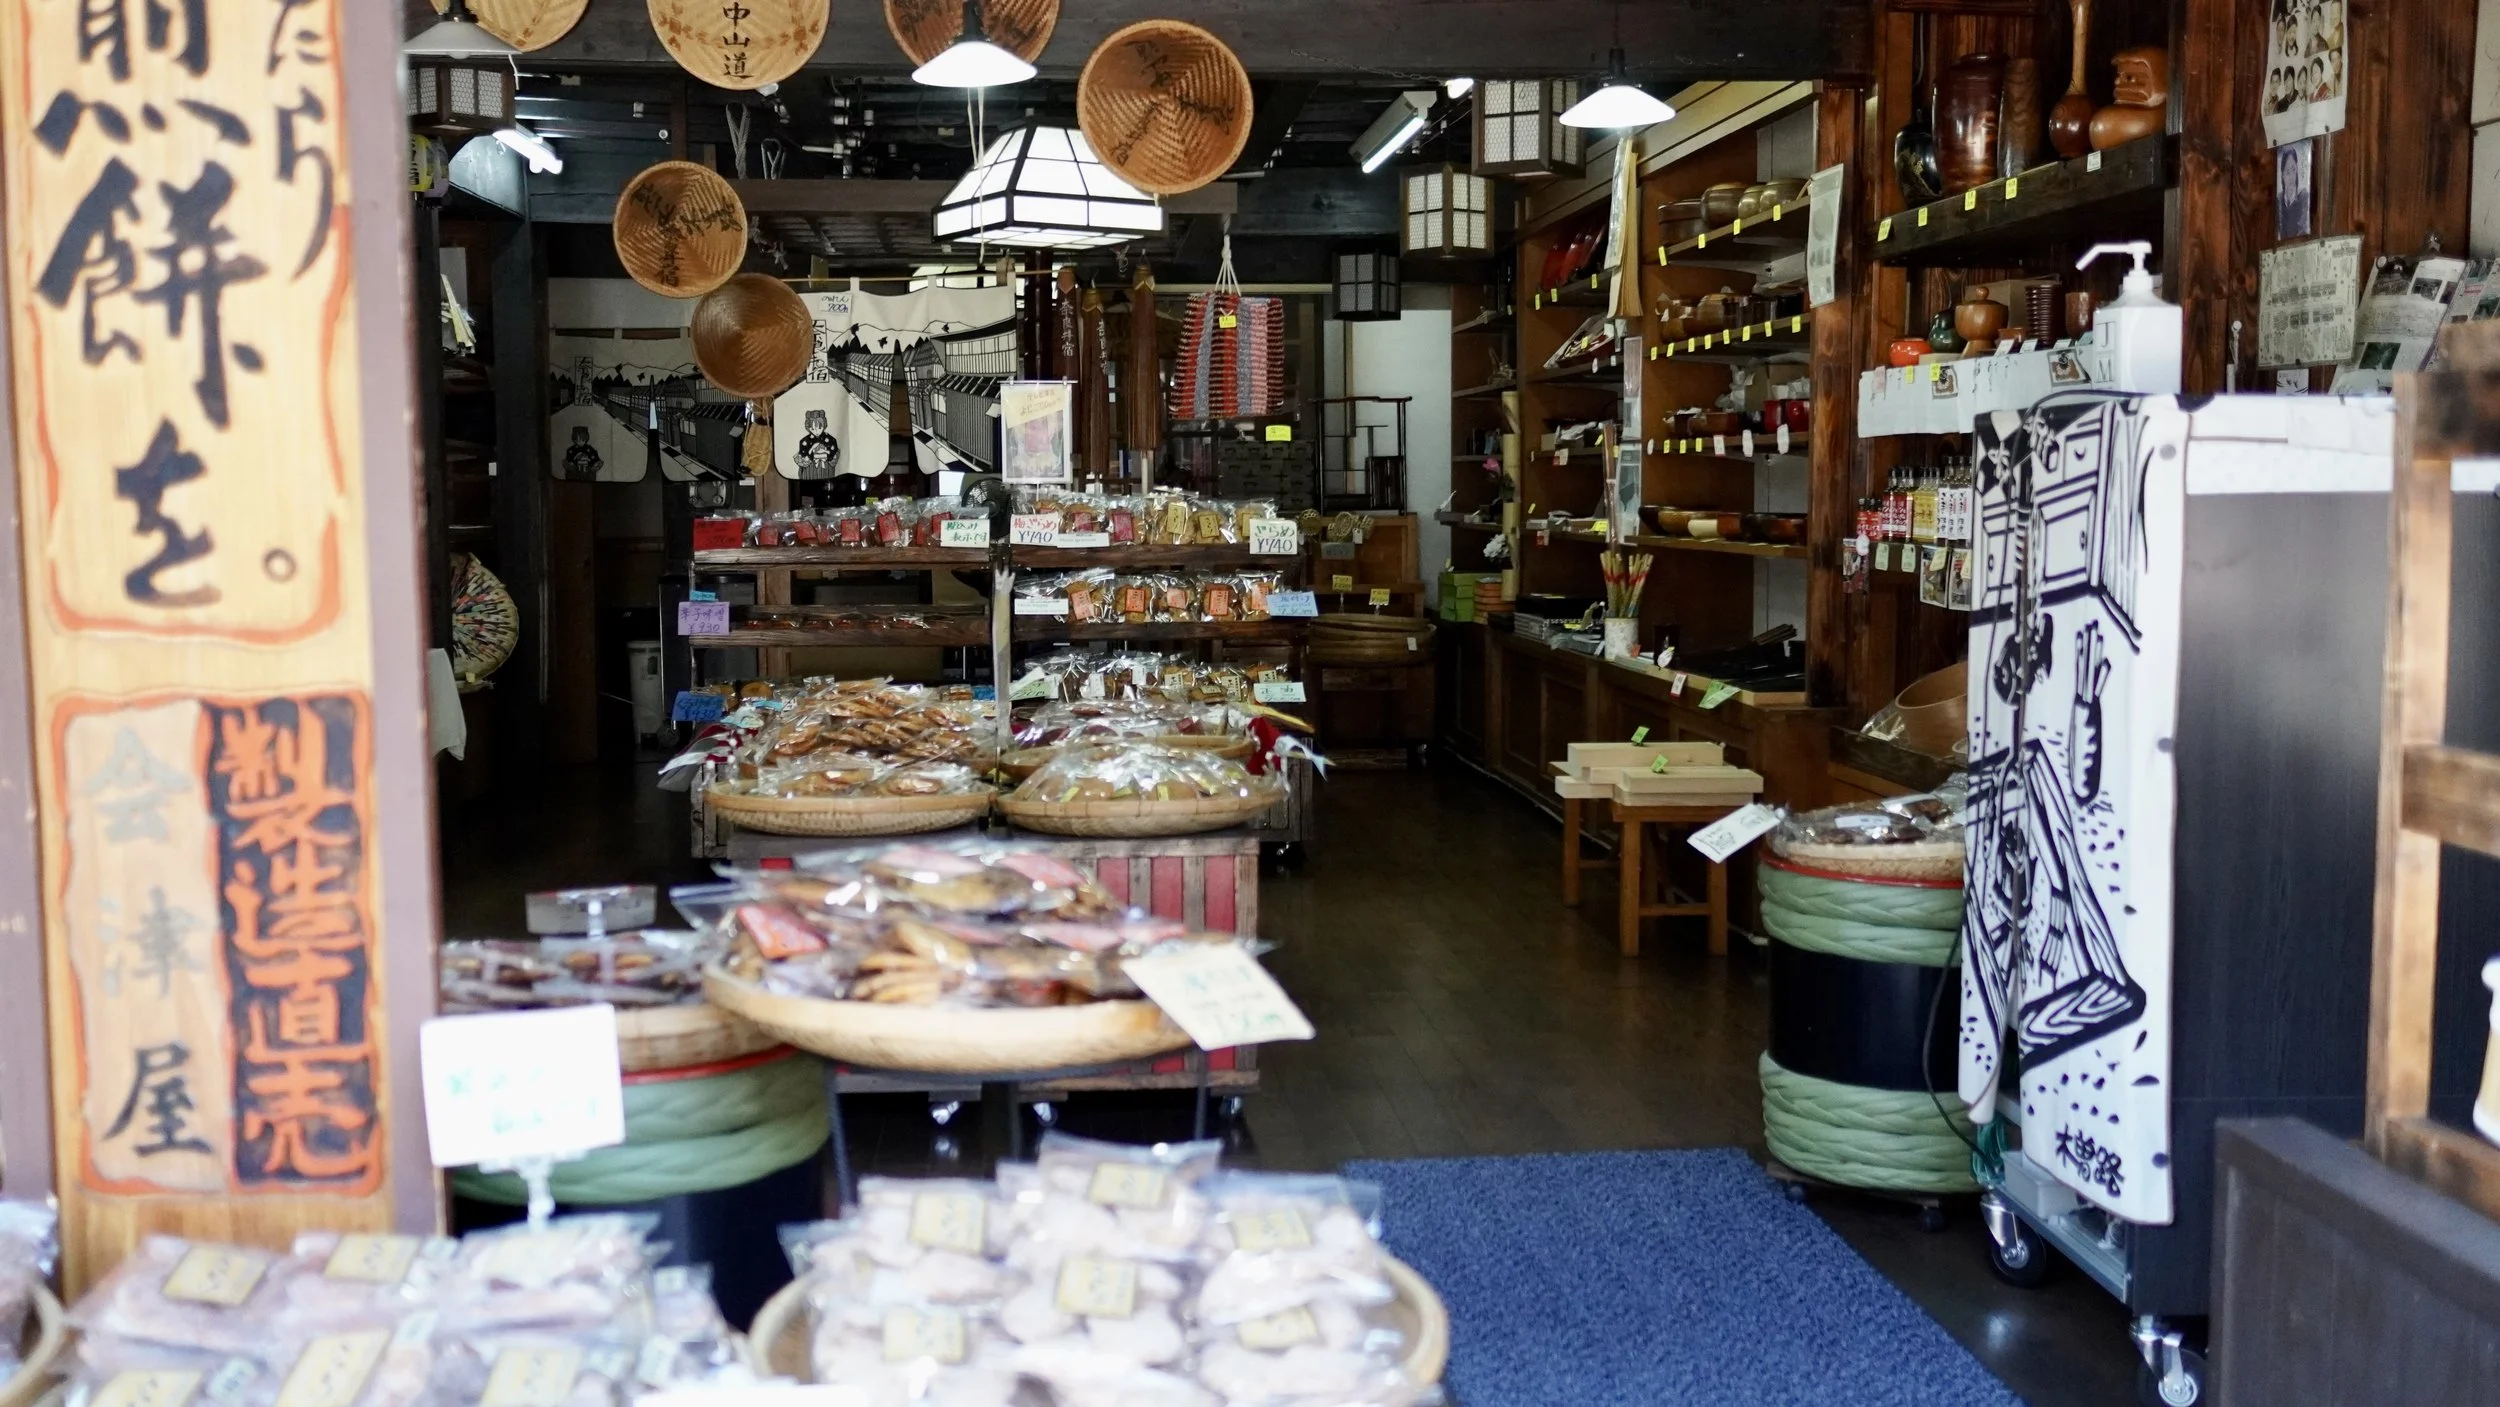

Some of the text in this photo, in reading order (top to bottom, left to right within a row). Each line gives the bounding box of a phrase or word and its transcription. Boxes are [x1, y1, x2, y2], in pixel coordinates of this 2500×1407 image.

[722, 2, 754, 79] 中山道
[1060, 299, 1074, 357] 奈良井宿
[1013, 517, 1057, 531] 梅ざらめ
[1018, 530, 1053, 543] ¥740
[1255, 526, 1295, 537] ざらめ
[1256, 538, 1292, 553] ¥740
[688, 622, 721, 634] ¥930
[87, 725, 216, 1159] 会津屋
[213, 698, 375, 1177] 製造直売
[2055, 1121, 2125, 1198] 木曽路
